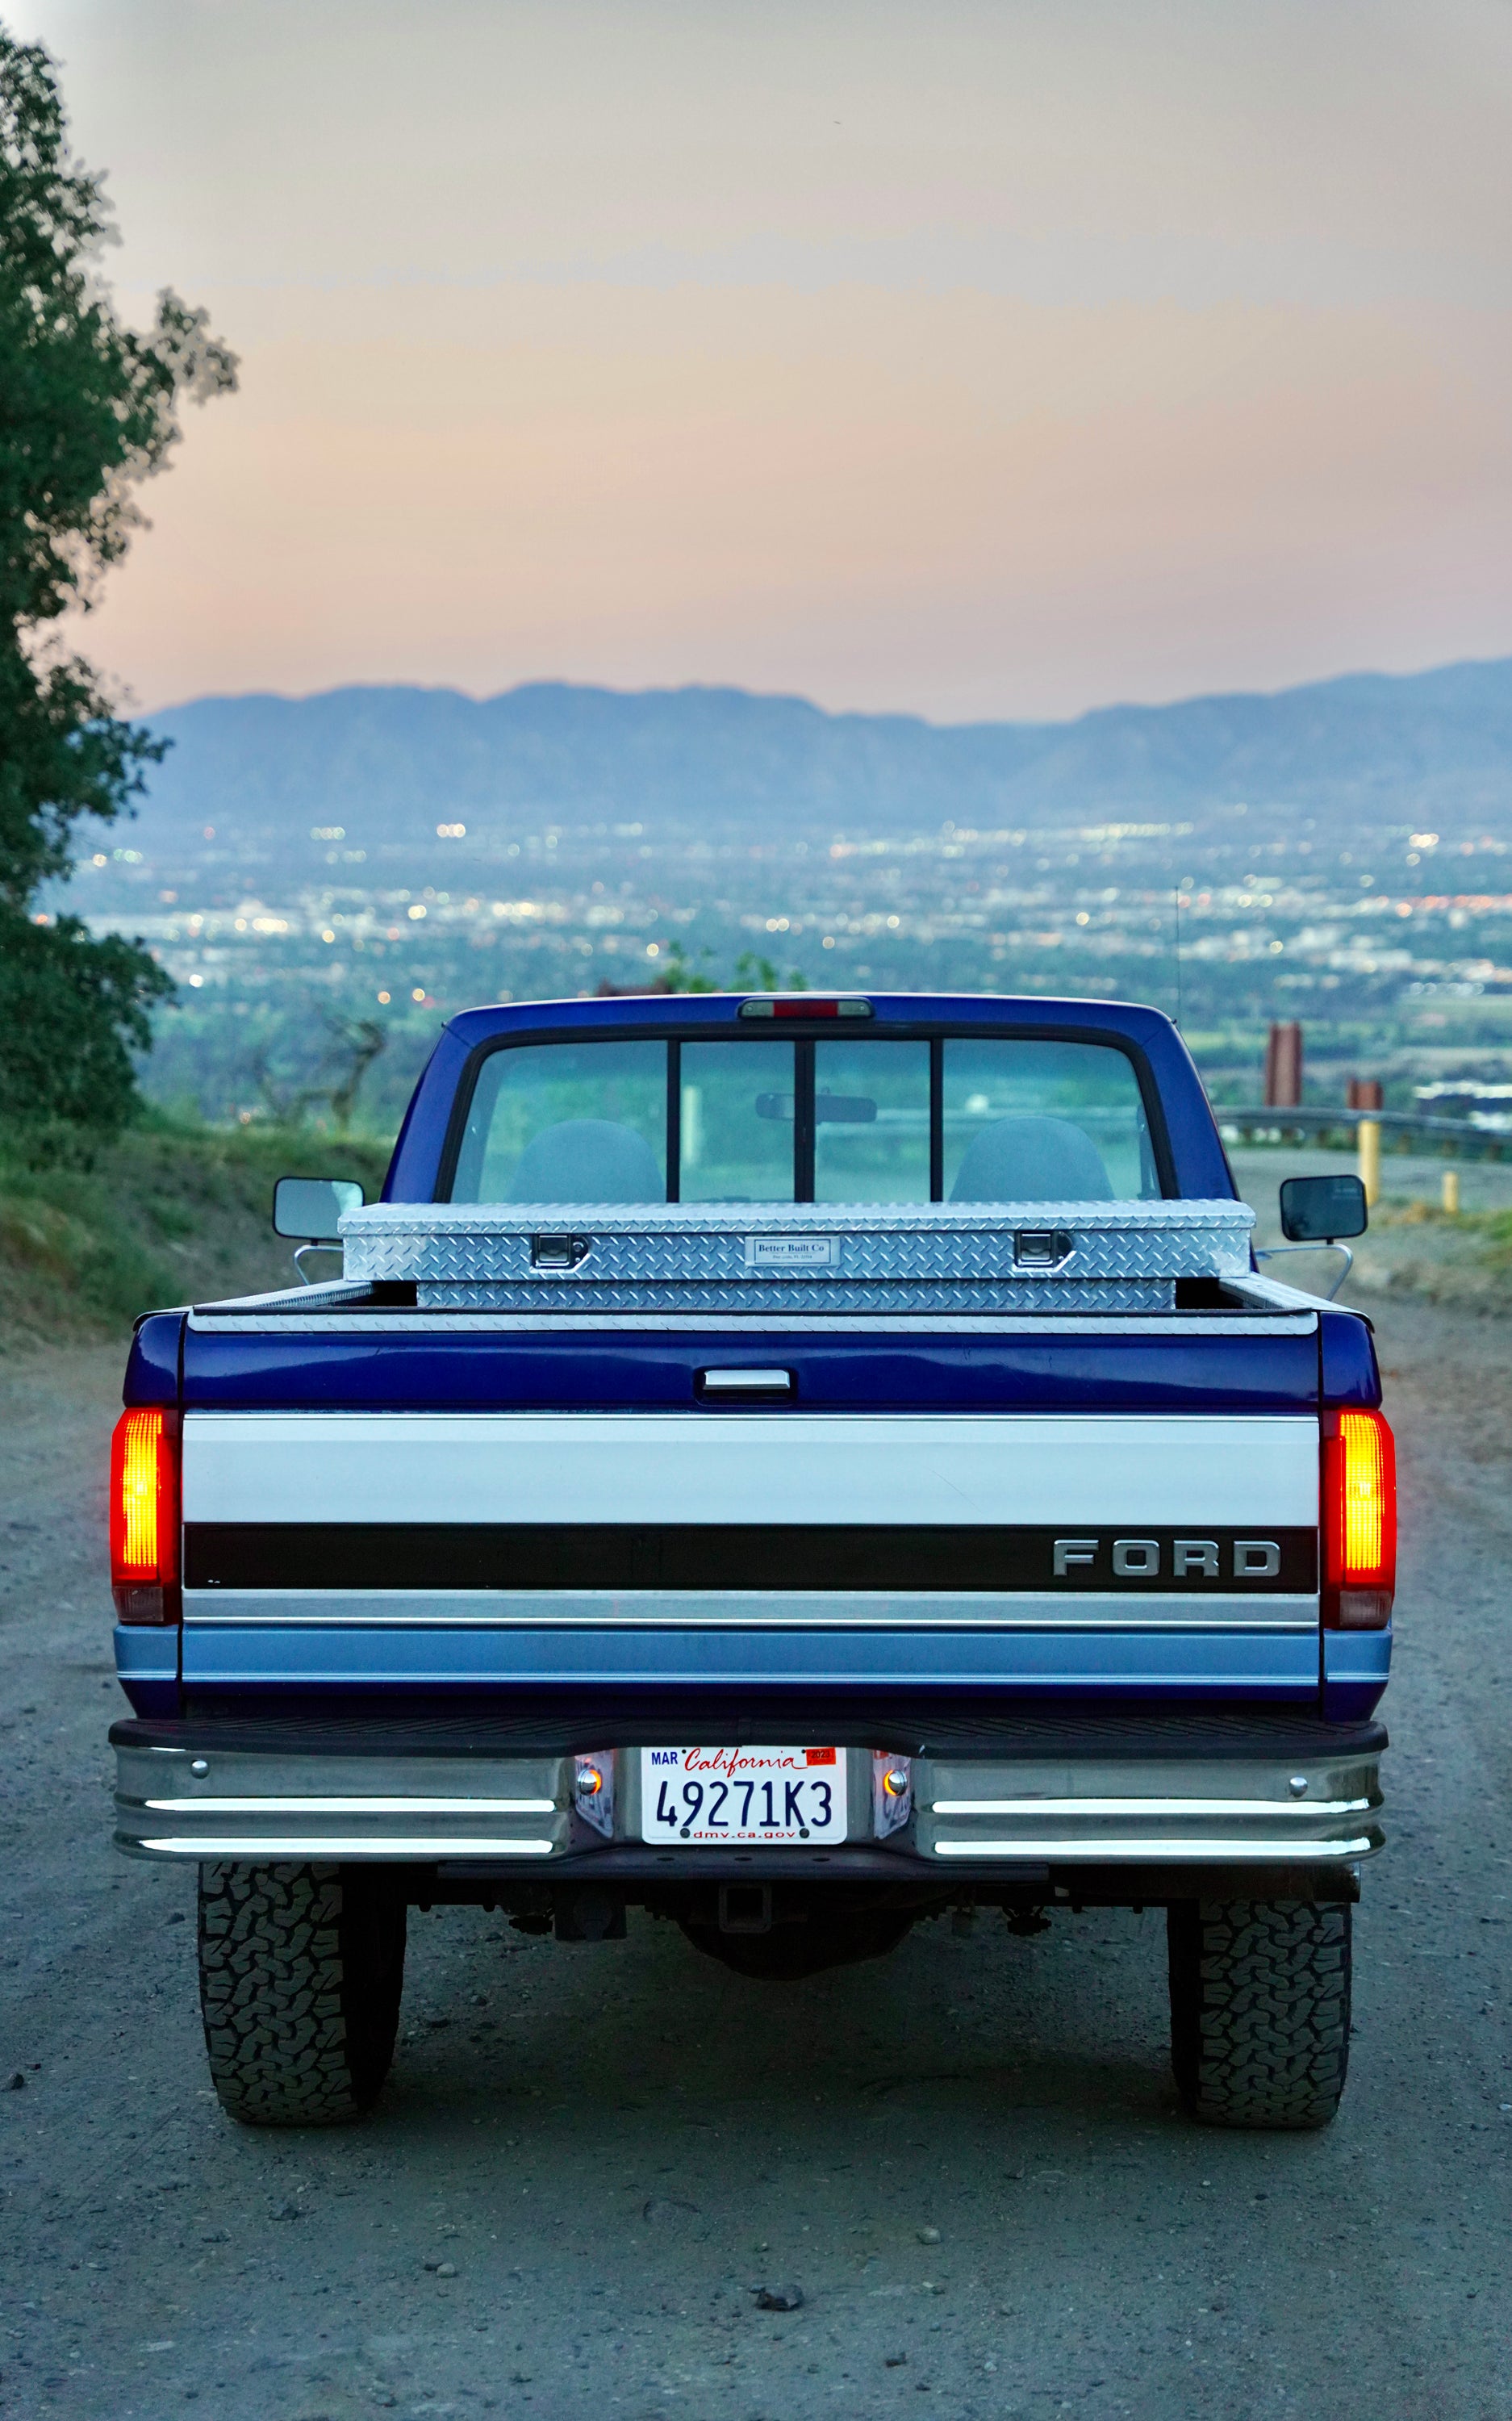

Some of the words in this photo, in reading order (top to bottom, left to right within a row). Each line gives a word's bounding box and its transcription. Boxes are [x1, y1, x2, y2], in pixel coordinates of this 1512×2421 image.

[758, 1244, 785, 1252] Better
[788, 1244, 808, 1252] Built
[812, 1244, 825, 1252] Co
[1053, 1539, 1281, 1577] FORD
[651, 1751, 679, 1766] MAR
[811, 1750, 830, 1758] 2023
[684, 1747, 808, 1779] California
[656, 1780, 832, 1827] 49271K3
[693, 1830, 796, 1839] dmv.ca.gov
